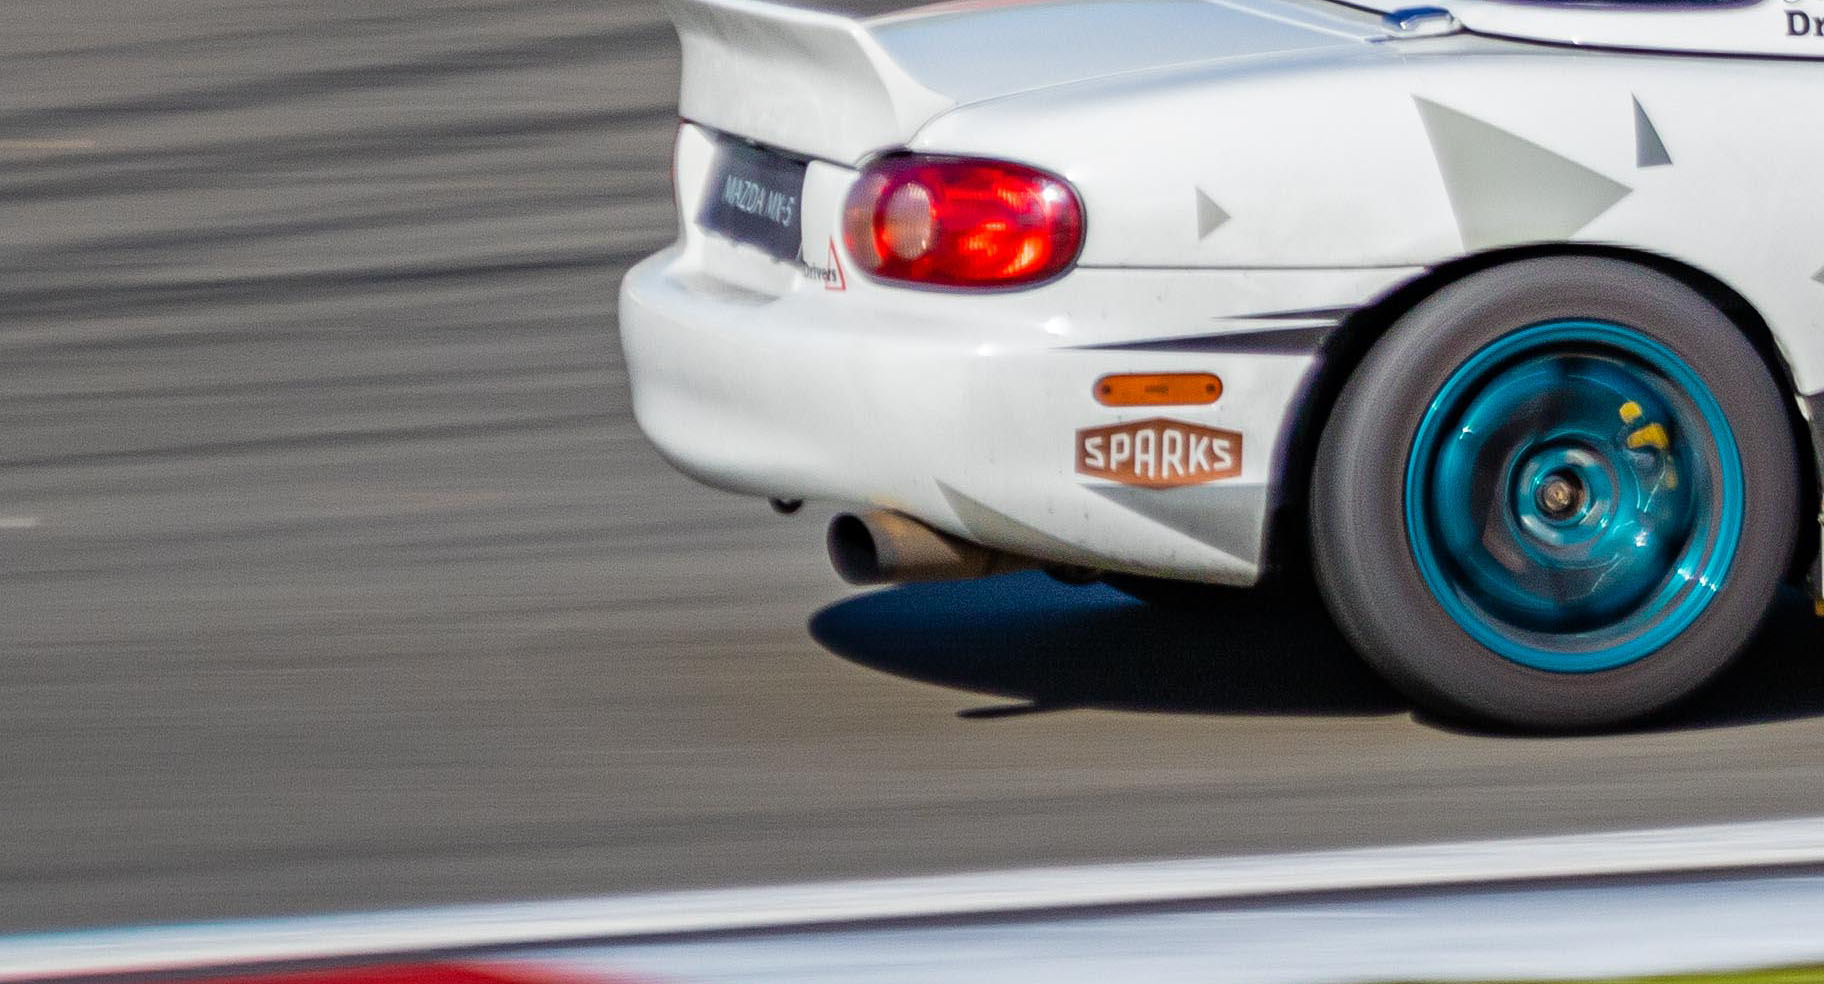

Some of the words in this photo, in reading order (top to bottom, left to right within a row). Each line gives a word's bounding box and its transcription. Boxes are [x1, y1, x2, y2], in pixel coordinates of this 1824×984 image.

[725, 174, 767, 216] MAZDA
[767, 190, 795, 227] MX-5
[803, 262, 837, 282] Drivers
[1084, 428, 1233, 480] SPARKS
